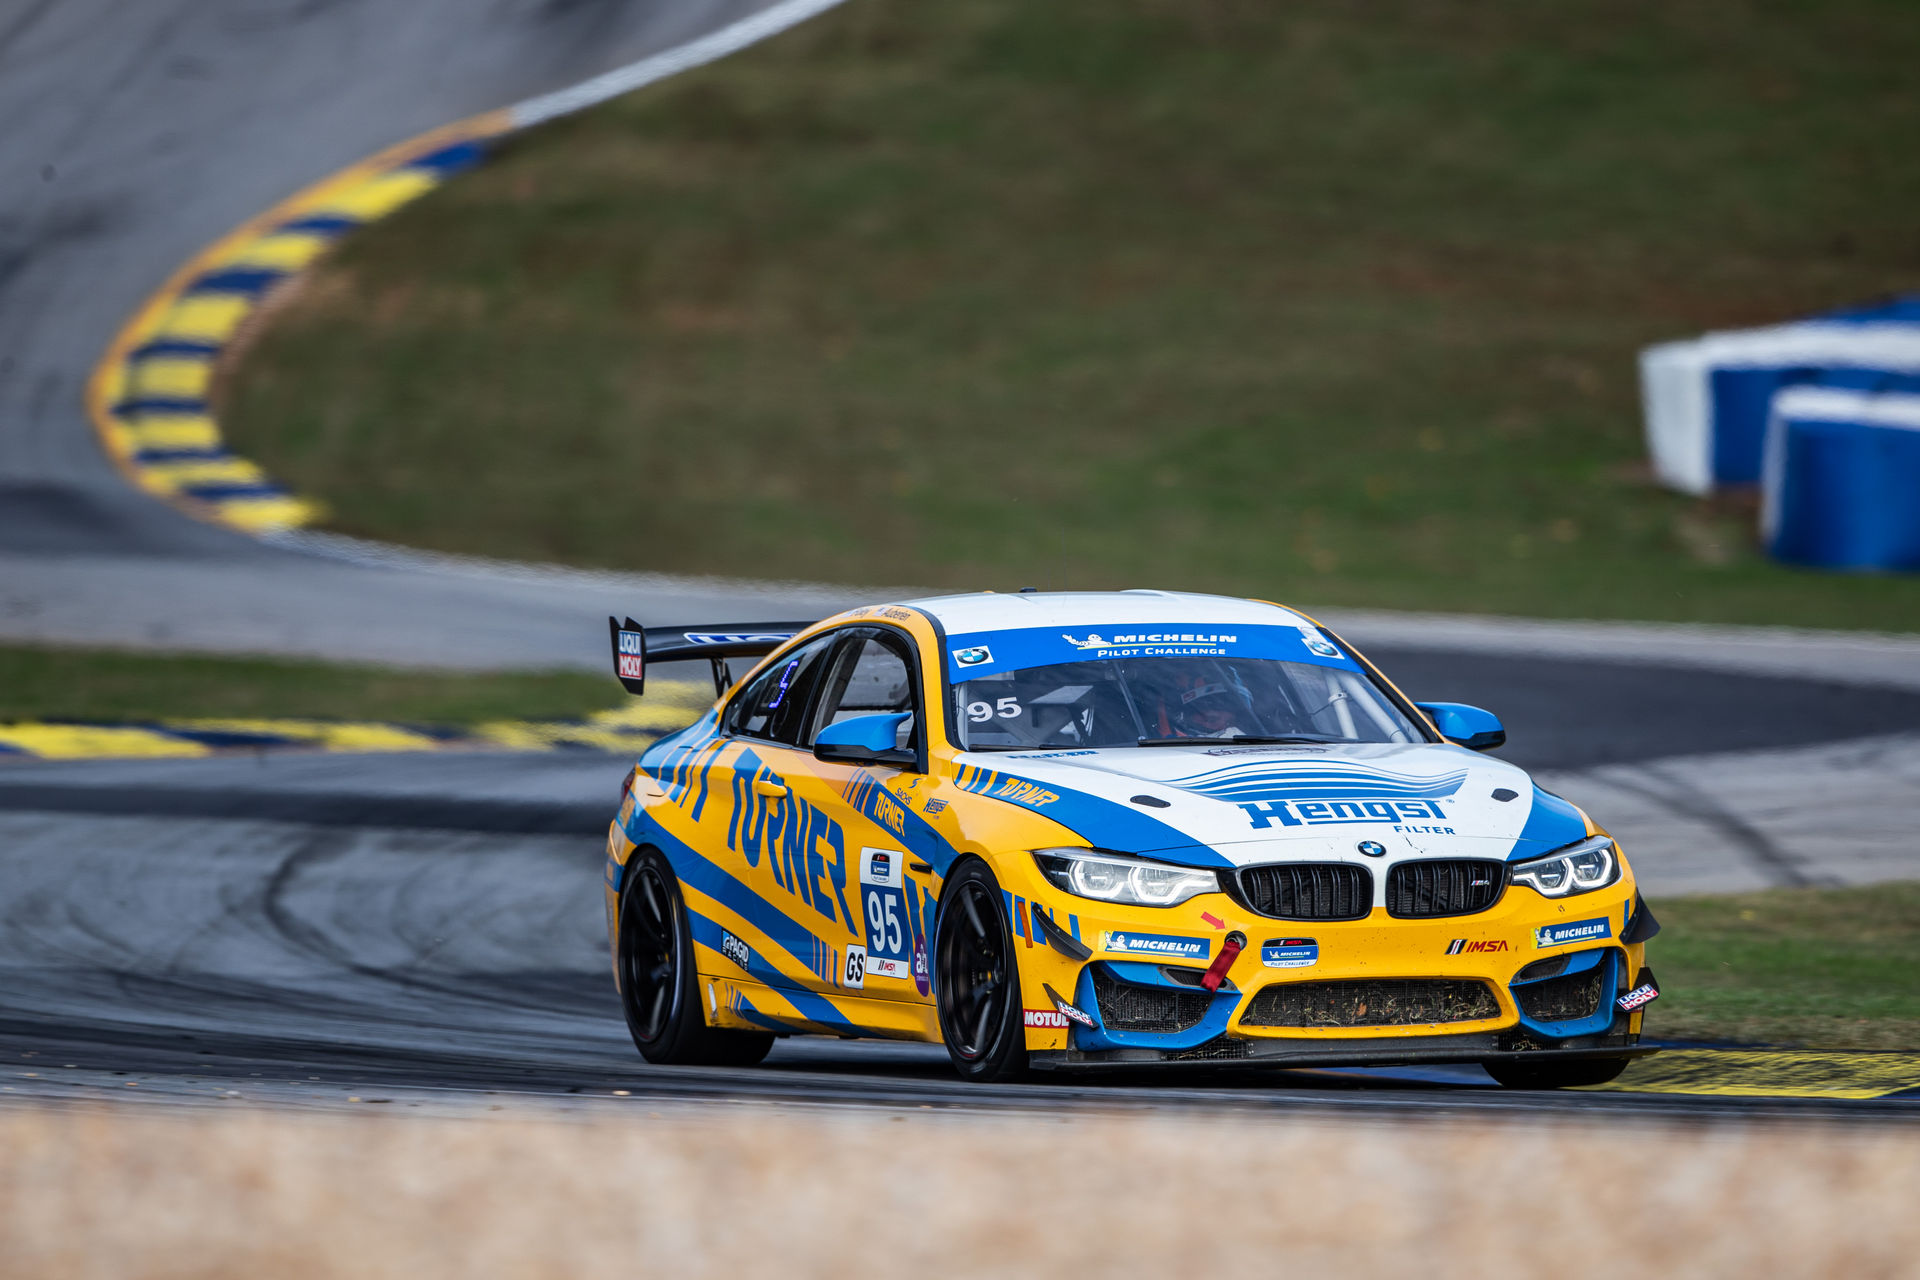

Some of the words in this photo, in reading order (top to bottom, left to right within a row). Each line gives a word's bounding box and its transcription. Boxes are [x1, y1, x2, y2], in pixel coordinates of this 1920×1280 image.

[619, 632, 641, 655] LIQUI
[1114, 634, 1237, 643] MICHELIN
[1097, 648, 1139, 658] PILOT
[1144, 647, 1226, 656] CHALLENGE
[619, 655, 642, 678] MOLY
[967, 696, 1022, 723] 95
[895, 787, 912, 805] SACHS
[996, 777, 1060, 807] TURNER
[874, 791, 906, 837] TURNER
[1236, 799, 1448, 830] Hengst
[1393, 825, 1456, 835] FILTER
[728, 747, 860, 938] TURNER
[868, 890, 903, 955] 95
[1554, 923, 1605, 940] MICHELIN
[729, 934, 750, 963] PAGID
[1129, 938, 1201, 953] MICHELIN
[1466, 940, 1509, 953] IMSA
[846, 951, 864, 982] GS
[1617, 983, 1653, 1006] LIQUI
[1625, 990, 1659, 1011] MOLY
[1024, 1011, 1070, 1027] MOTUL
[1057, 1000, 1092, 1021] LIQUI
[1059, 1007, 1094, 1026] MOLY
